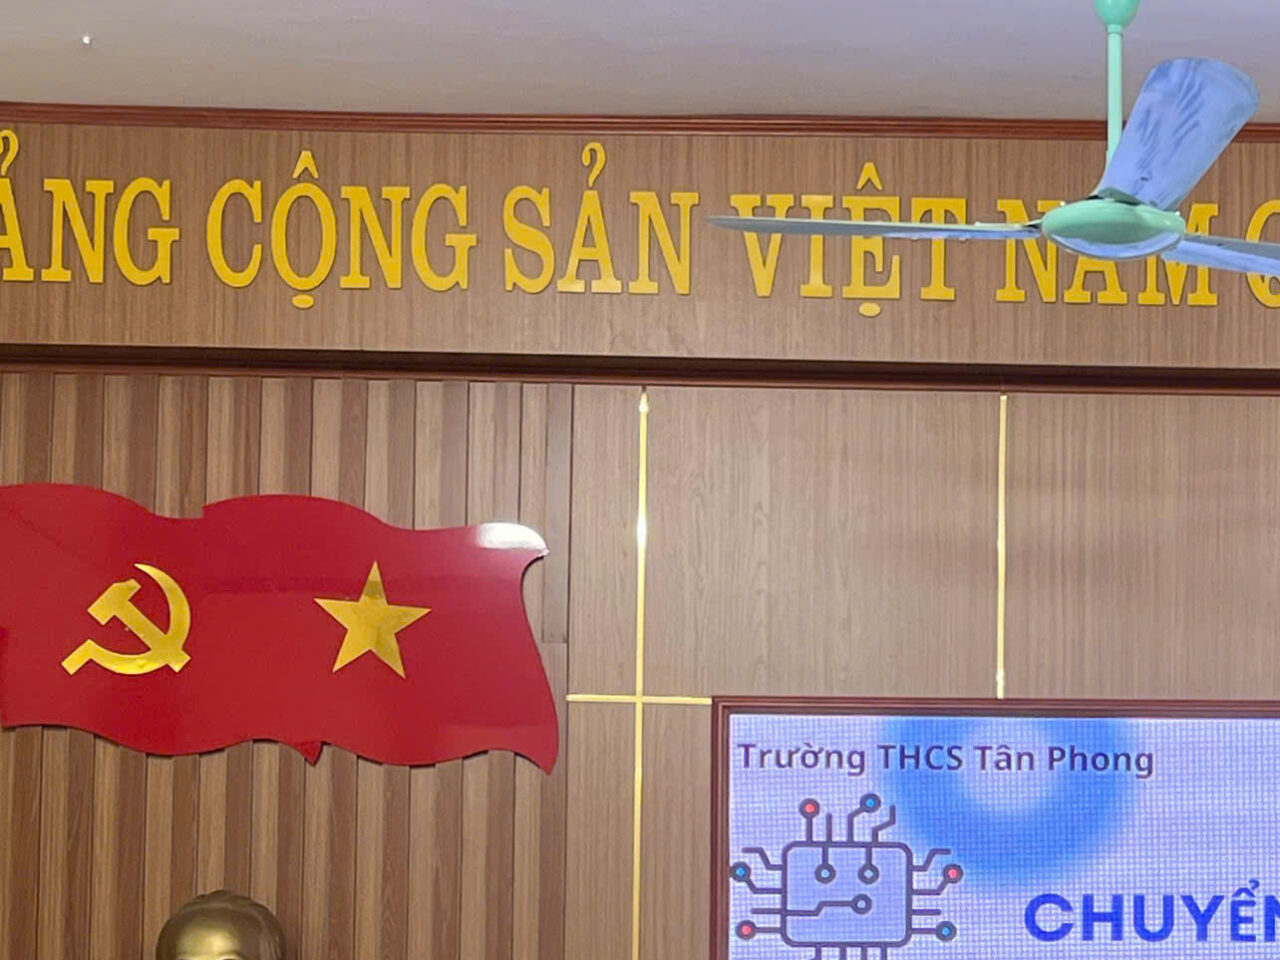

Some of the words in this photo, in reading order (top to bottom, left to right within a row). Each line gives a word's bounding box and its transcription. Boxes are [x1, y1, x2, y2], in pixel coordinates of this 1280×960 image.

[206, 151, 477, 309] CỘNG
[504, 142, 699, 294] SẢN
[730, 162, 967, 317] VIỆT
[738, 743, 866, 776] Trường
[879, 744, 963, 771] THCS
[974, 743, 1035, 772] Tân
[1048, 744, 1154, 778] Phong
